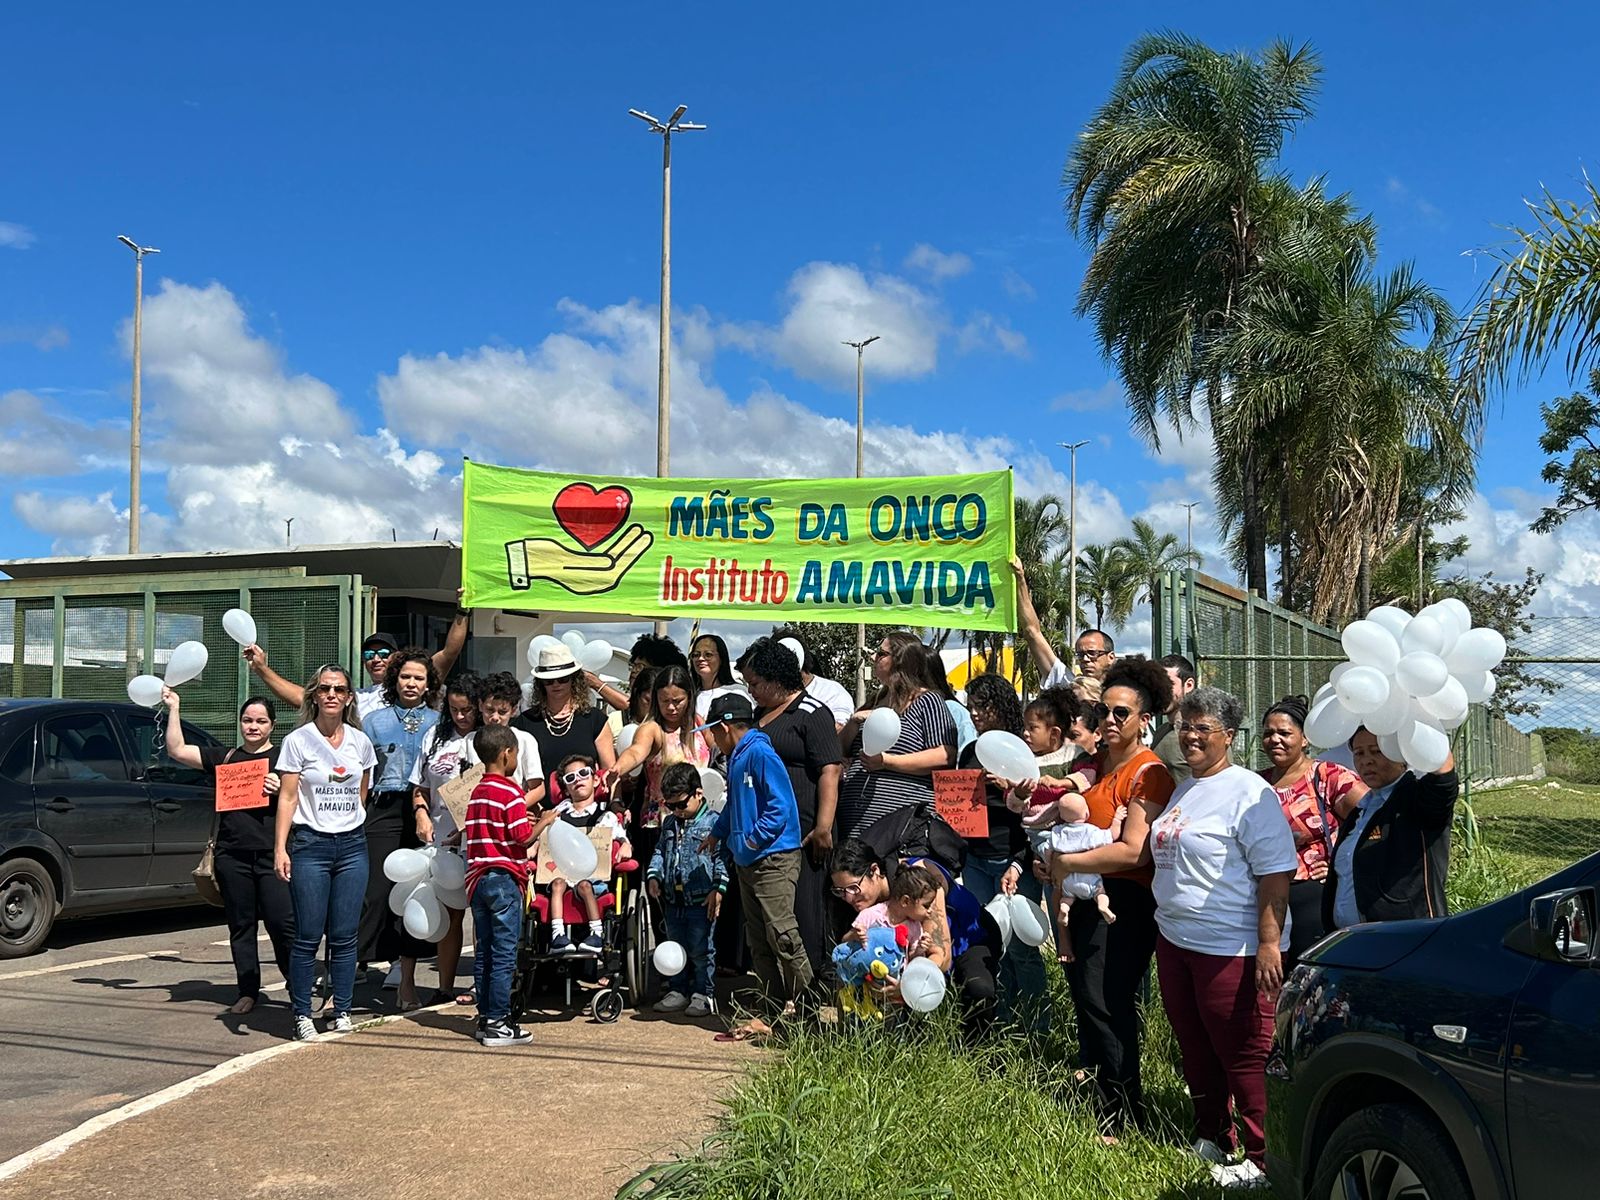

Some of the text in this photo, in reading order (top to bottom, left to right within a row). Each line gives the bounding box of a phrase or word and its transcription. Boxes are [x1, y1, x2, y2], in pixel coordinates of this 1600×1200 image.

[667, 488, 988, 545] MÃES DA ONCO
[660, 554, 996, 611] Instituto AMAVIDA
[318, 803, 355, 811] AMAVIDA
